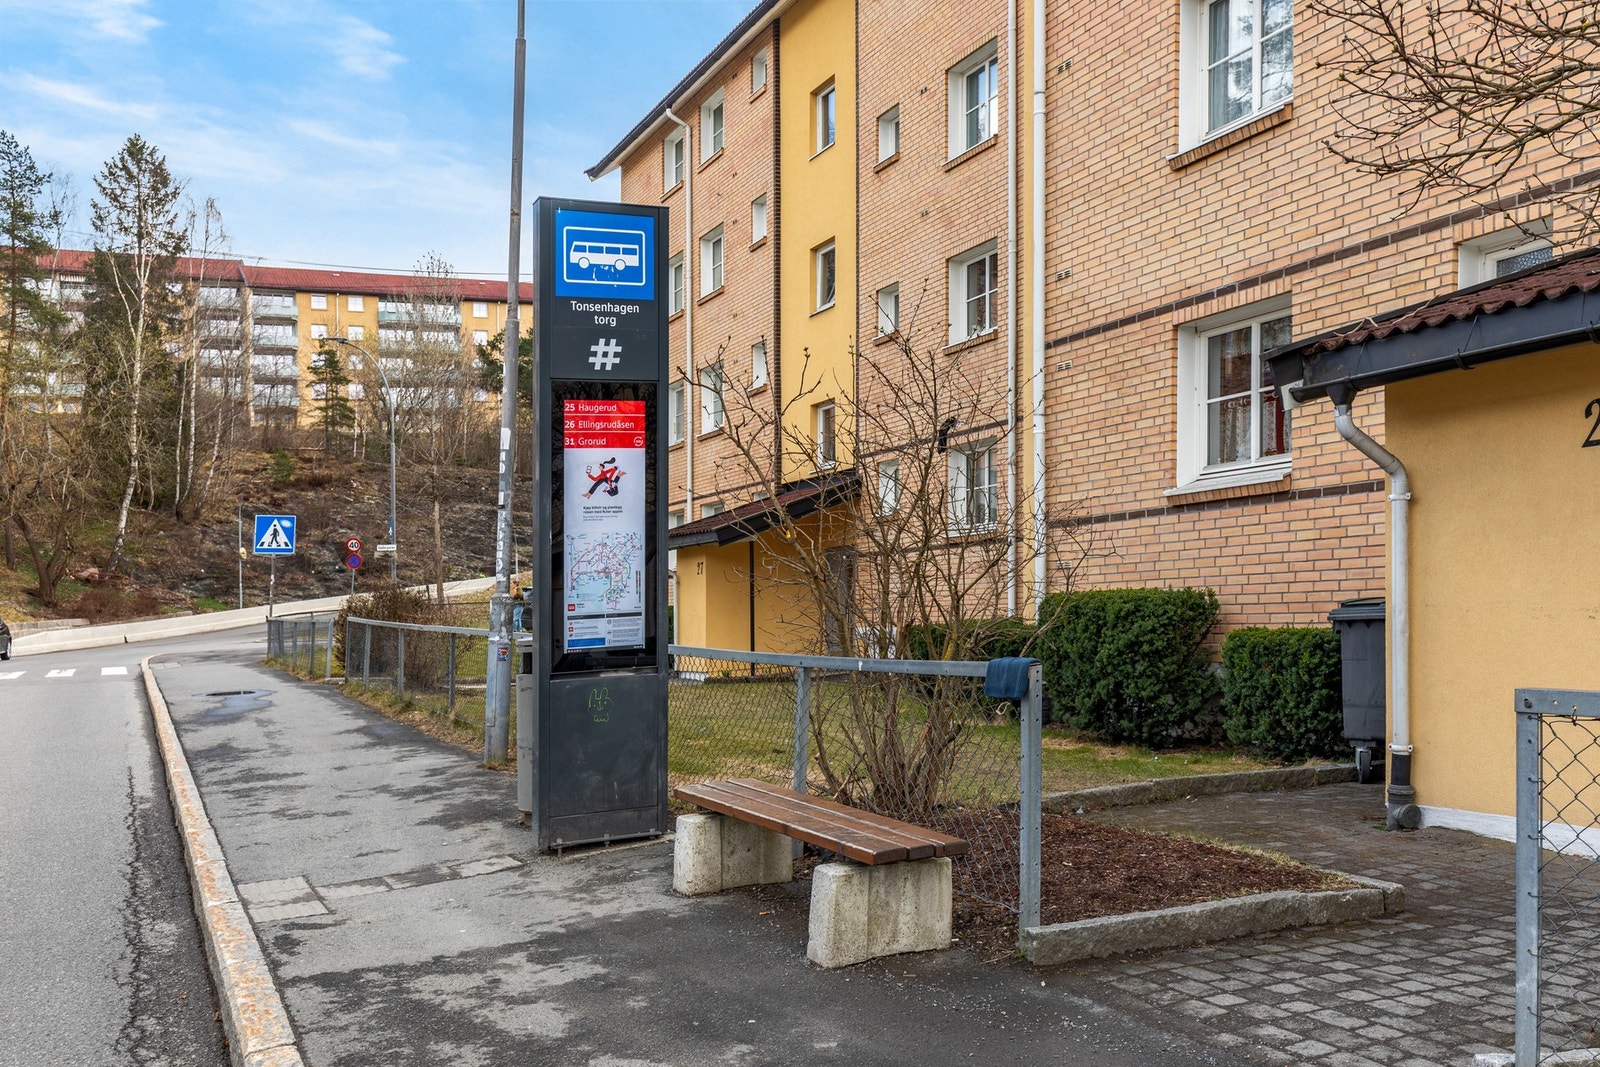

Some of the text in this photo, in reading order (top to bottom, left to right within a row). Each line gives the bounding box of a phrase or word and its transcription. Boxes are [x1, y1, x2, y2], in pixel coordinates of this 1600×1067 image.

[570, 300, 640, 315] Tonsenhagen
[594, 315, 617, 327] torg
[564, 403, 617, 413] 25 Haugerud
[564, 420, 635, 430] 26 Ellingsrudåsen
[1581, 398, 1600, 448] 2
[564, 437, 607, 446] 31 Grorud
[349, 541, 359, 549] 40
[696, 561, 704, 576] 27
